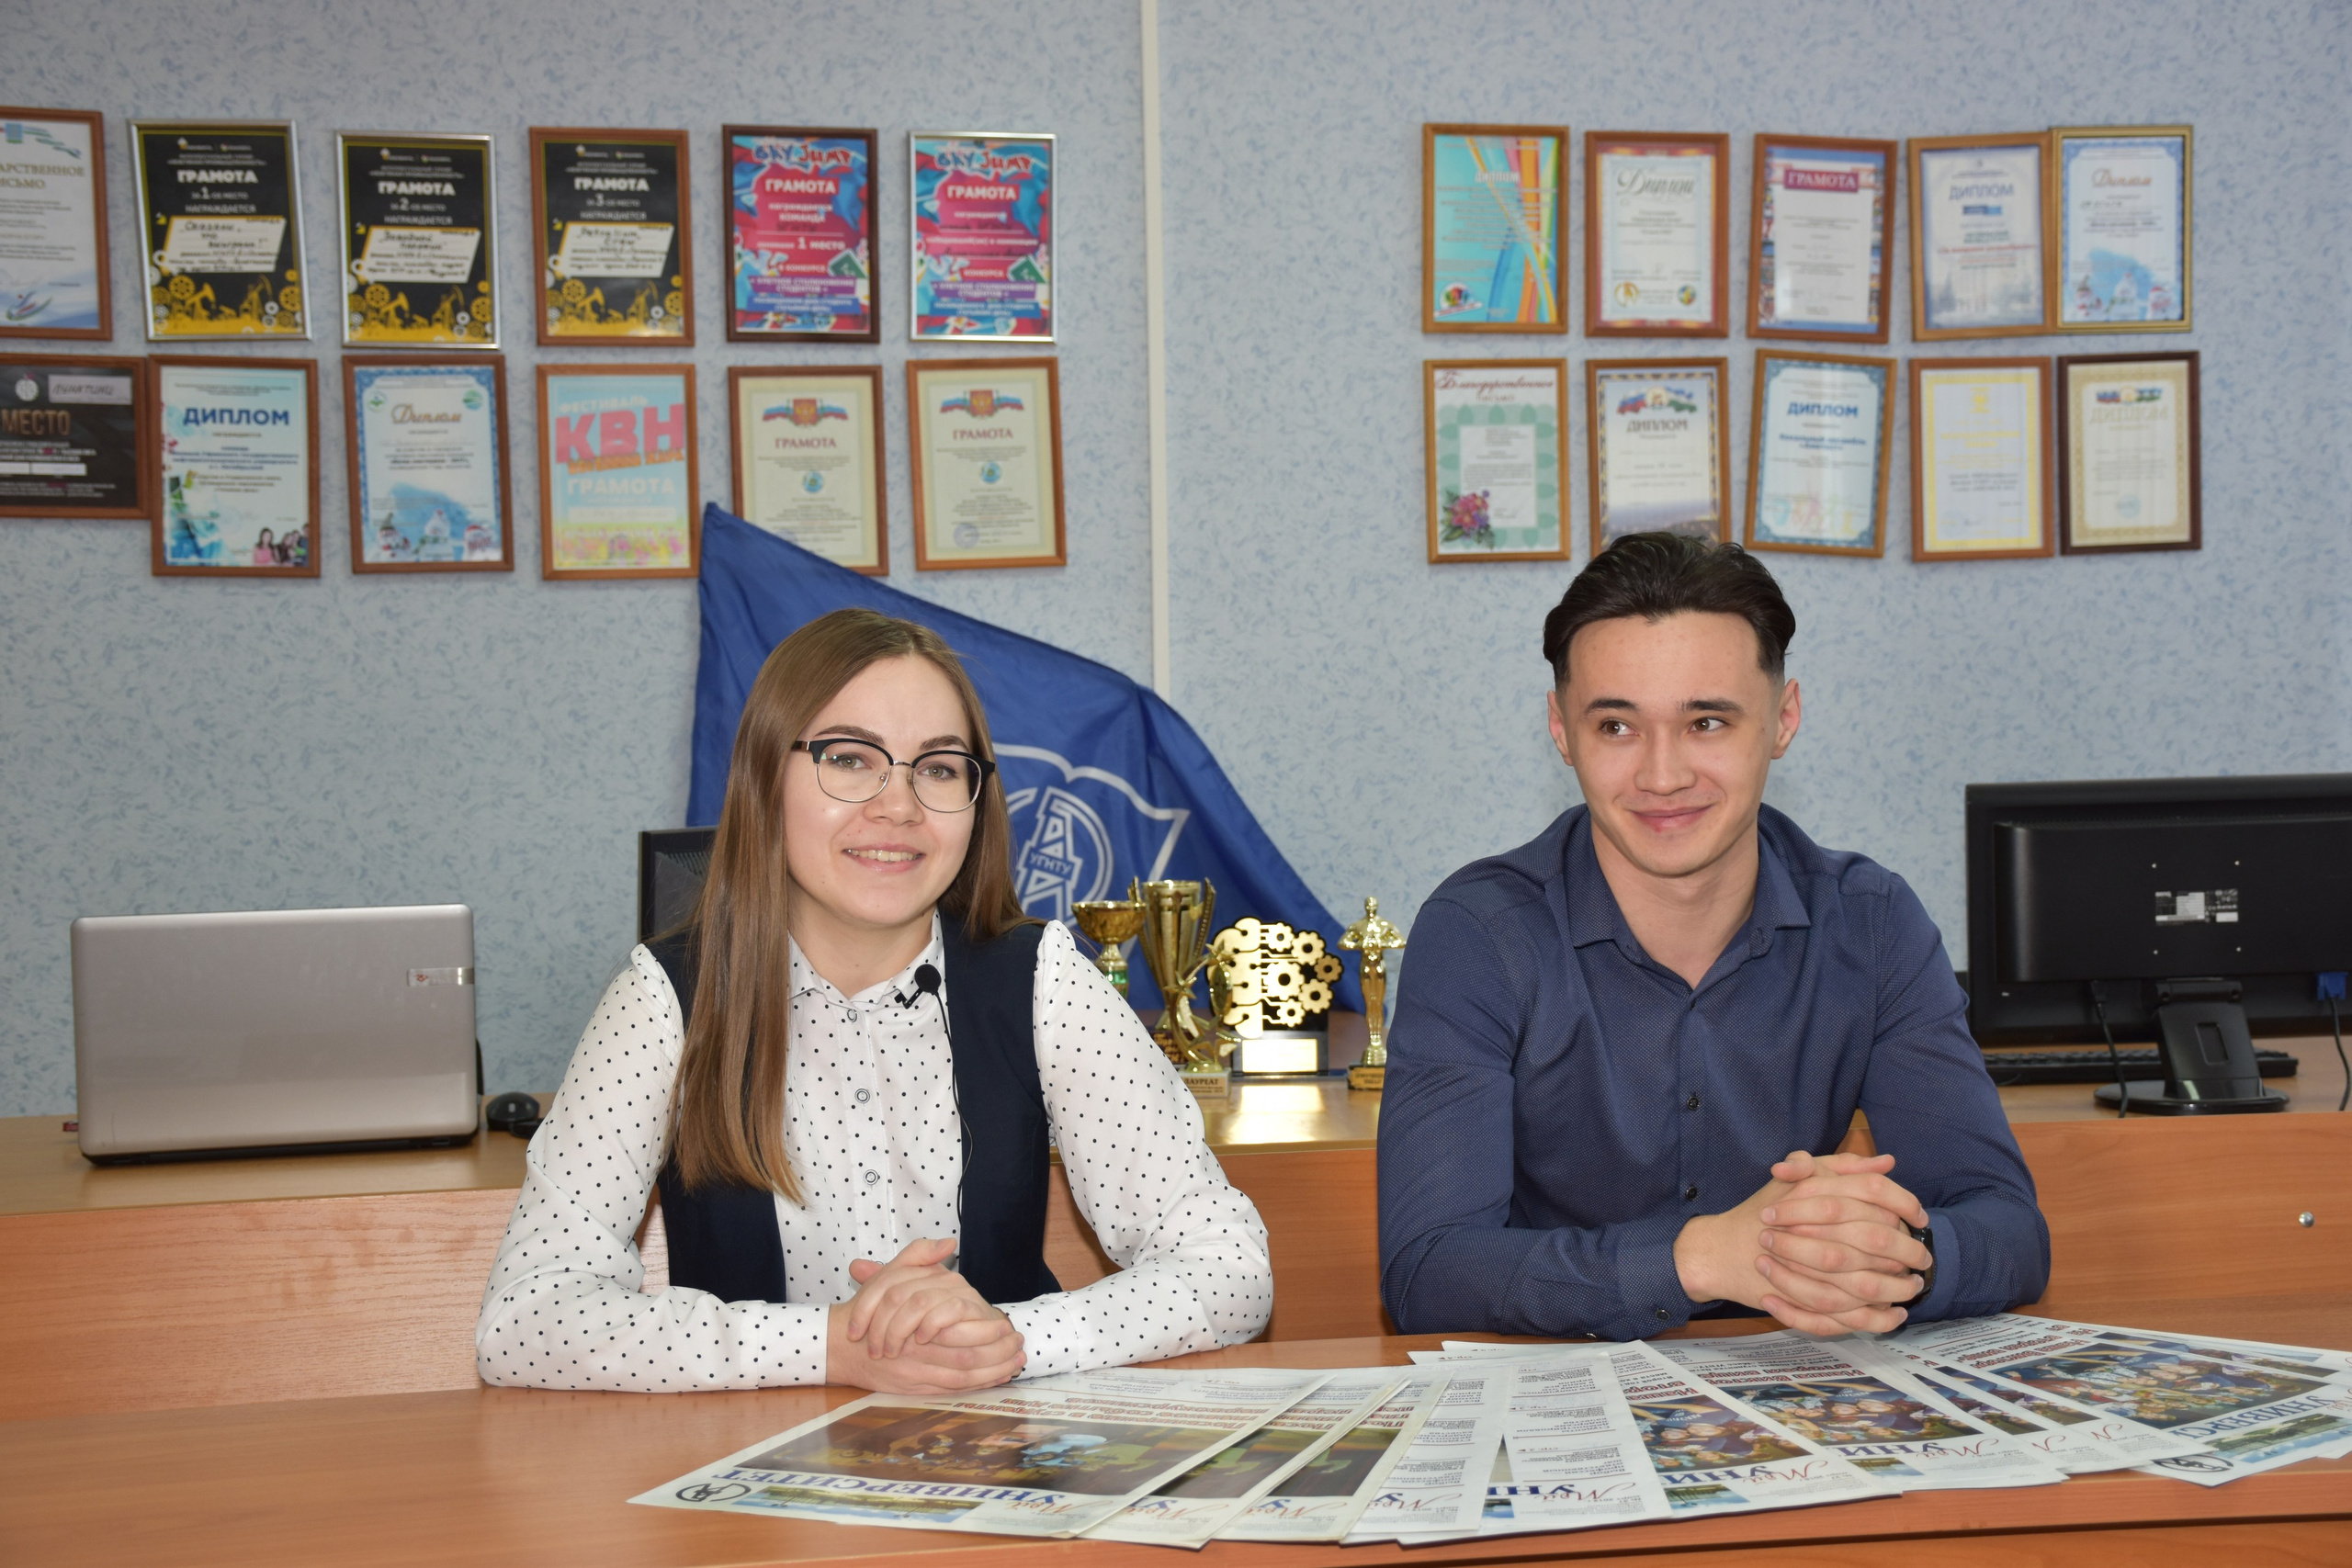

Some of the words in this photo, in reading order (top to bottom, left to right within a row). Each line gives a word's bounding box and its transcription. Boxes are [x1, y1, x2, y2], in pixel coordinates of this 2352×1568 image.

[177, 170, 258, 184] ГРАМОТА
[573, 177, 650, 191] ГРАМОТА
[1788, 172, 1856, 188] ГРАМОТА
[378, 181, 456, 196] ГРАМОТА
[764, 178, 837, 194] ГРАМОТА
[946, 185, 1016, 200] ГРАМОТА
[1949, 184, 2014, 200] ДИПЛОМ
[797, 237, 807, 249] 1
[183, 407, 289, 426] ДИПЛОМ
[391, 403, 462, 423] Диплом
[1787, 401, 1860, 418] ДИПЛОМ
[2089, 405, 2170, 423] ДИПЛОМ
[0, 408, 71, 436] МЕСТО
[1626, 419, 1689, 433] ДИПЛОМ
[555, 403, 684, 464] КВН
[953, 427, 1013, 440] ГРАМОТА
[775, 437, 837, 448] ГРАМОТА
[567, 477, 674, 494] ГРАМОТА
[1029, 852, 1072, 874] УГНТУ
[1792, 1369, 1866, 1379] Наша
[1625, 1387, 1700, 1401] Наша
[953, 1403, 1067, 1416] студенты
[999, 1398, 1050, 1411] для
[1048, 1404, 1155, 1416] событие
[1066, 1398, 1271, 1415] первокурсников
[1087, 1414, 1248, 1430] Посвящение
[1157, 1411, 1259, 1421] главное
[1915, 1438, 1998, 1460] Мой
[1743, 1461, 1829, 1484] Мой
[713, 1469, 1066, 1505] УНИВЕРСИТЕТ
[1534, 1483, 1635, 1504] Мой
[1003, 1499, 1110, 1516] Мой
[1121, 1504, 1229, 1518] Мой
[1246, 1502, 1348, 1518] Мой
